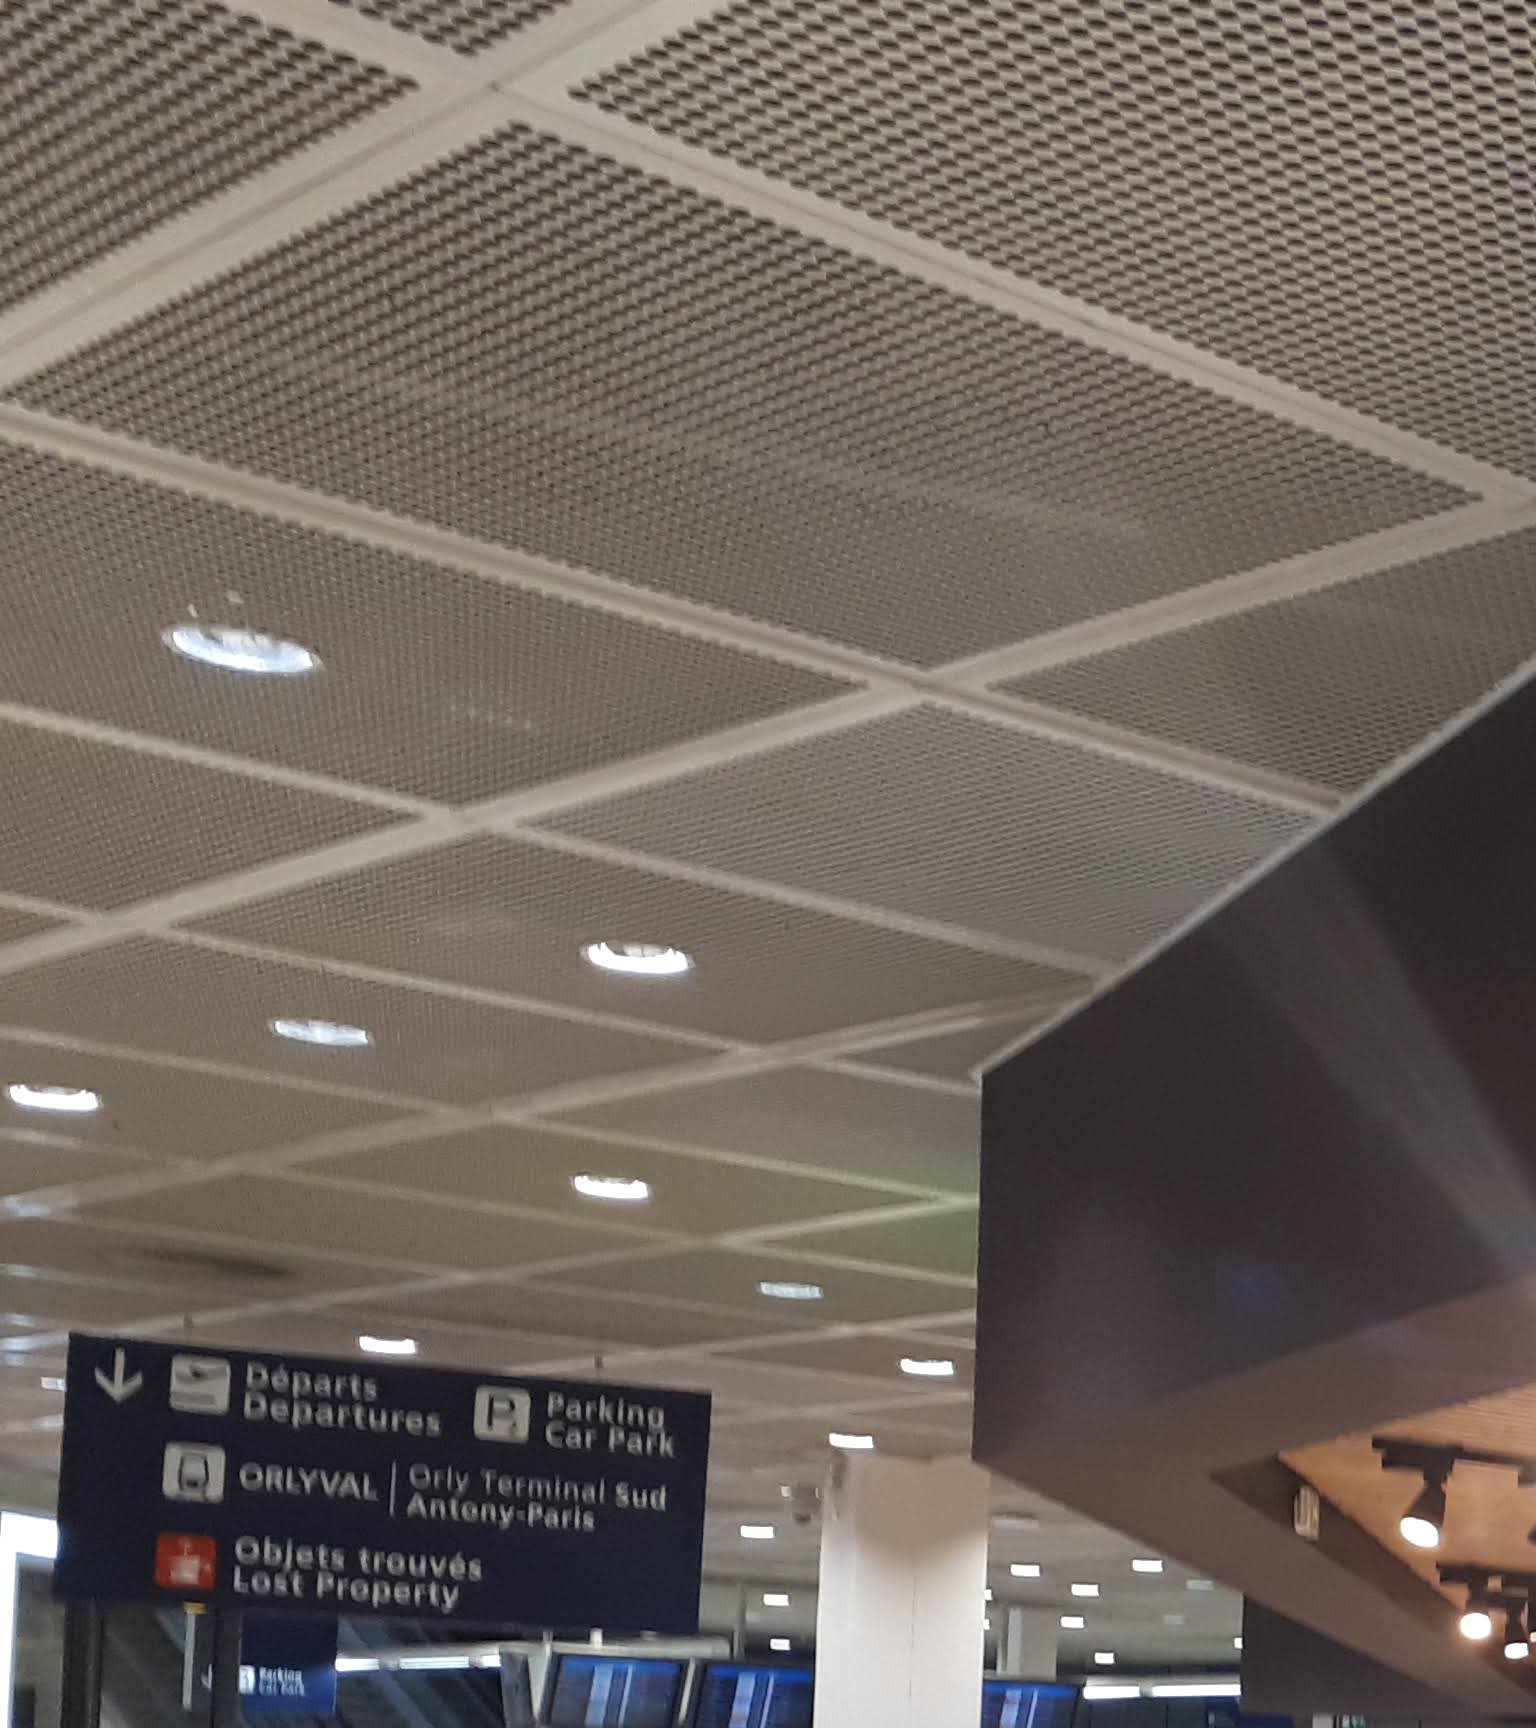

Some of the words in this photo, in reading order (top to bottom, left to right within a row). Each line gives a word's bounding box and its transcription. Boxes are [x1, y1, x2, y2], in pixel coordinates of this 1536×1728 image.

[246, 1361, 378, 1402] Départs
[243, 1390, 442, 1437] Departures
[547, 1391, 666, 1432] Parking
[545, 1419, 598, 1449] Car
[608, 1425, 676, 1459] Park
[239, 1461, 379, 1501] ORLYVAL
[408, 1462, 470, 1498] Orly
[480, 1467, 606, 1504] Terminal
[615, 1480, 667, 1512] Sud
[406, 1491, 595, 1531] Antony-Paris
[234, 1534, 346, 1573] Objets
[357, 1546, 483, 1583] trouvés
[233, 1564, 304, 1598] Lost
[316, 1570, 460, 1615] Property
